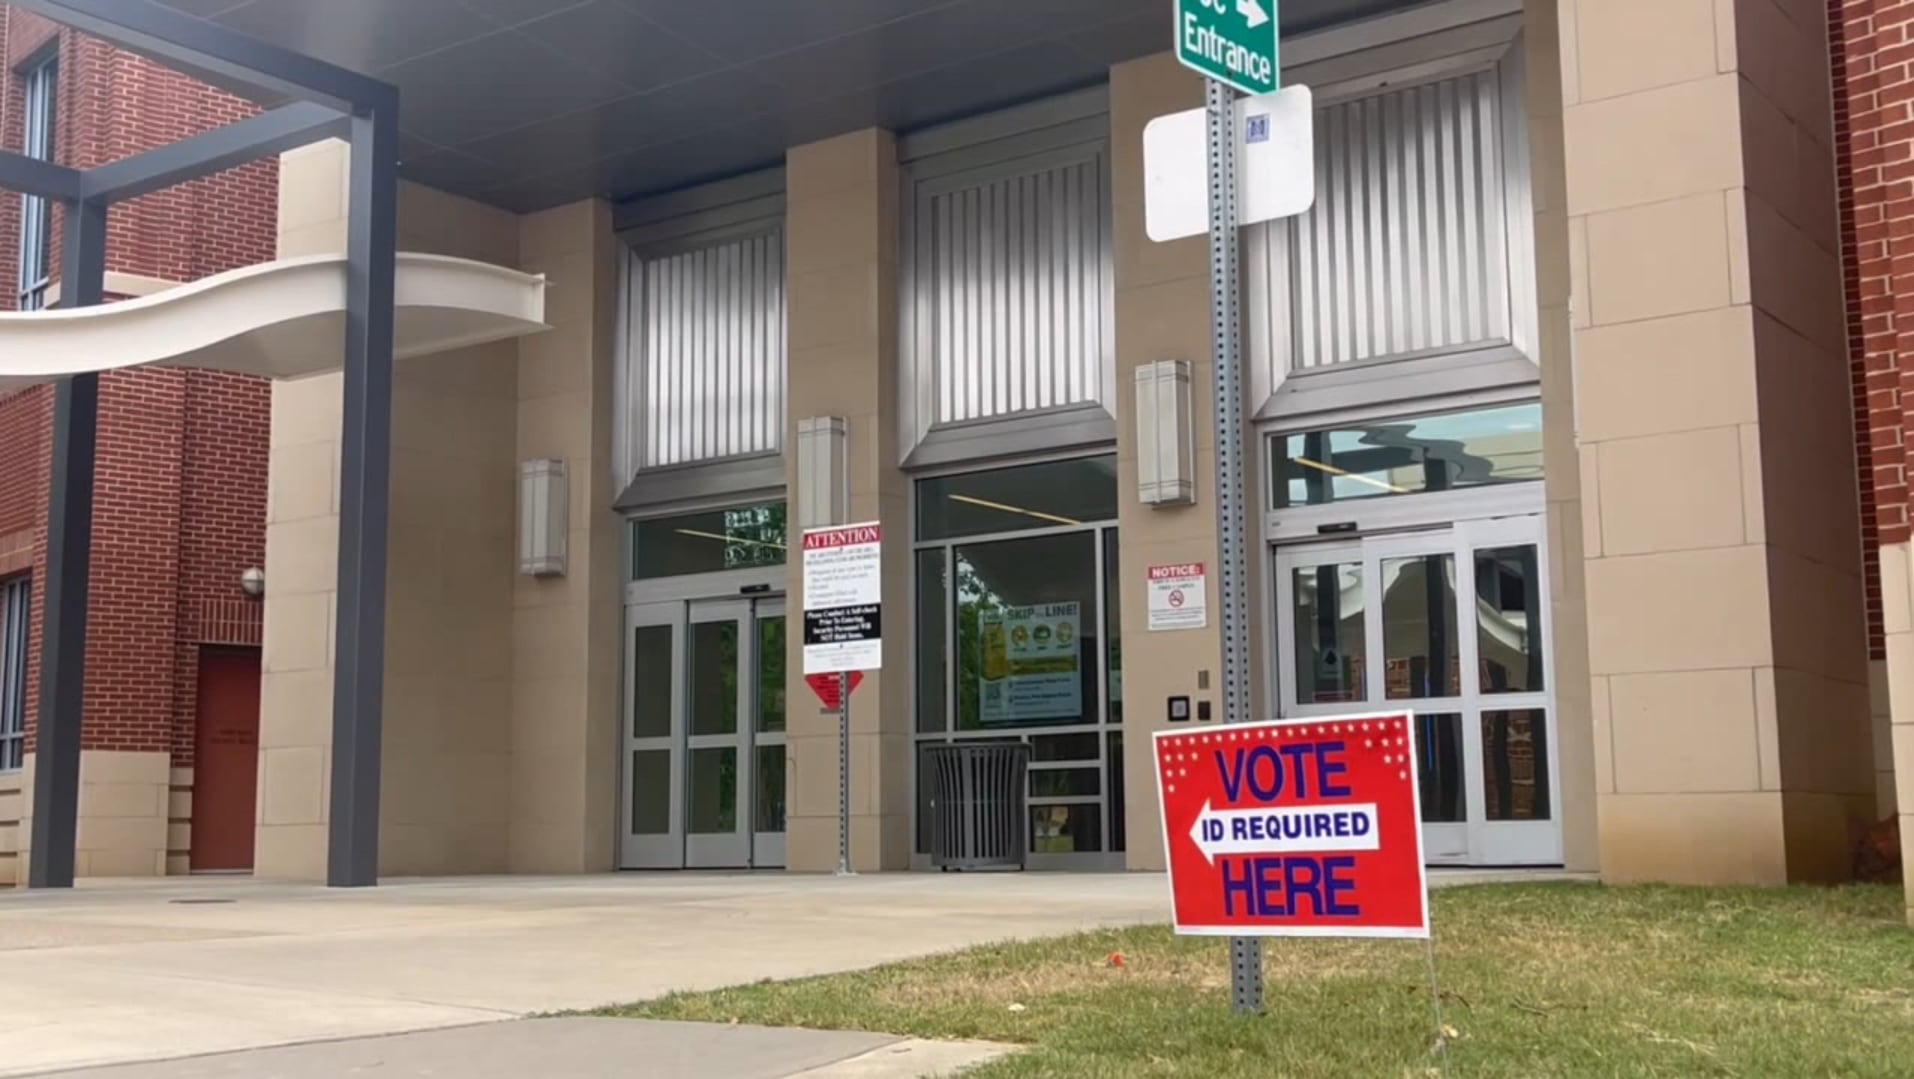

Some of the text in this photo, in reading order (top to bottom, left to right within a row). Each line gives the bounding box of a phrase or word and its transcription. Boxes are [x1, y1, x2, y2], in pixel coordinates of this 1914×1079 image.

[1184, 11, 1272, 85] Entrance
[806, 527, 878, 548] ATTENTION
[1152, 565, 1200, 578] NOTICE:
[1007, 607, 1034, 620] SKIP
[1045, 604, 1077, 617] LINE!
[1215, 741, 1351, 802] VOTE
[1202, 811, 1370, 842] ID REQUIRED
[1222, 856, 1360, 917] HERE
